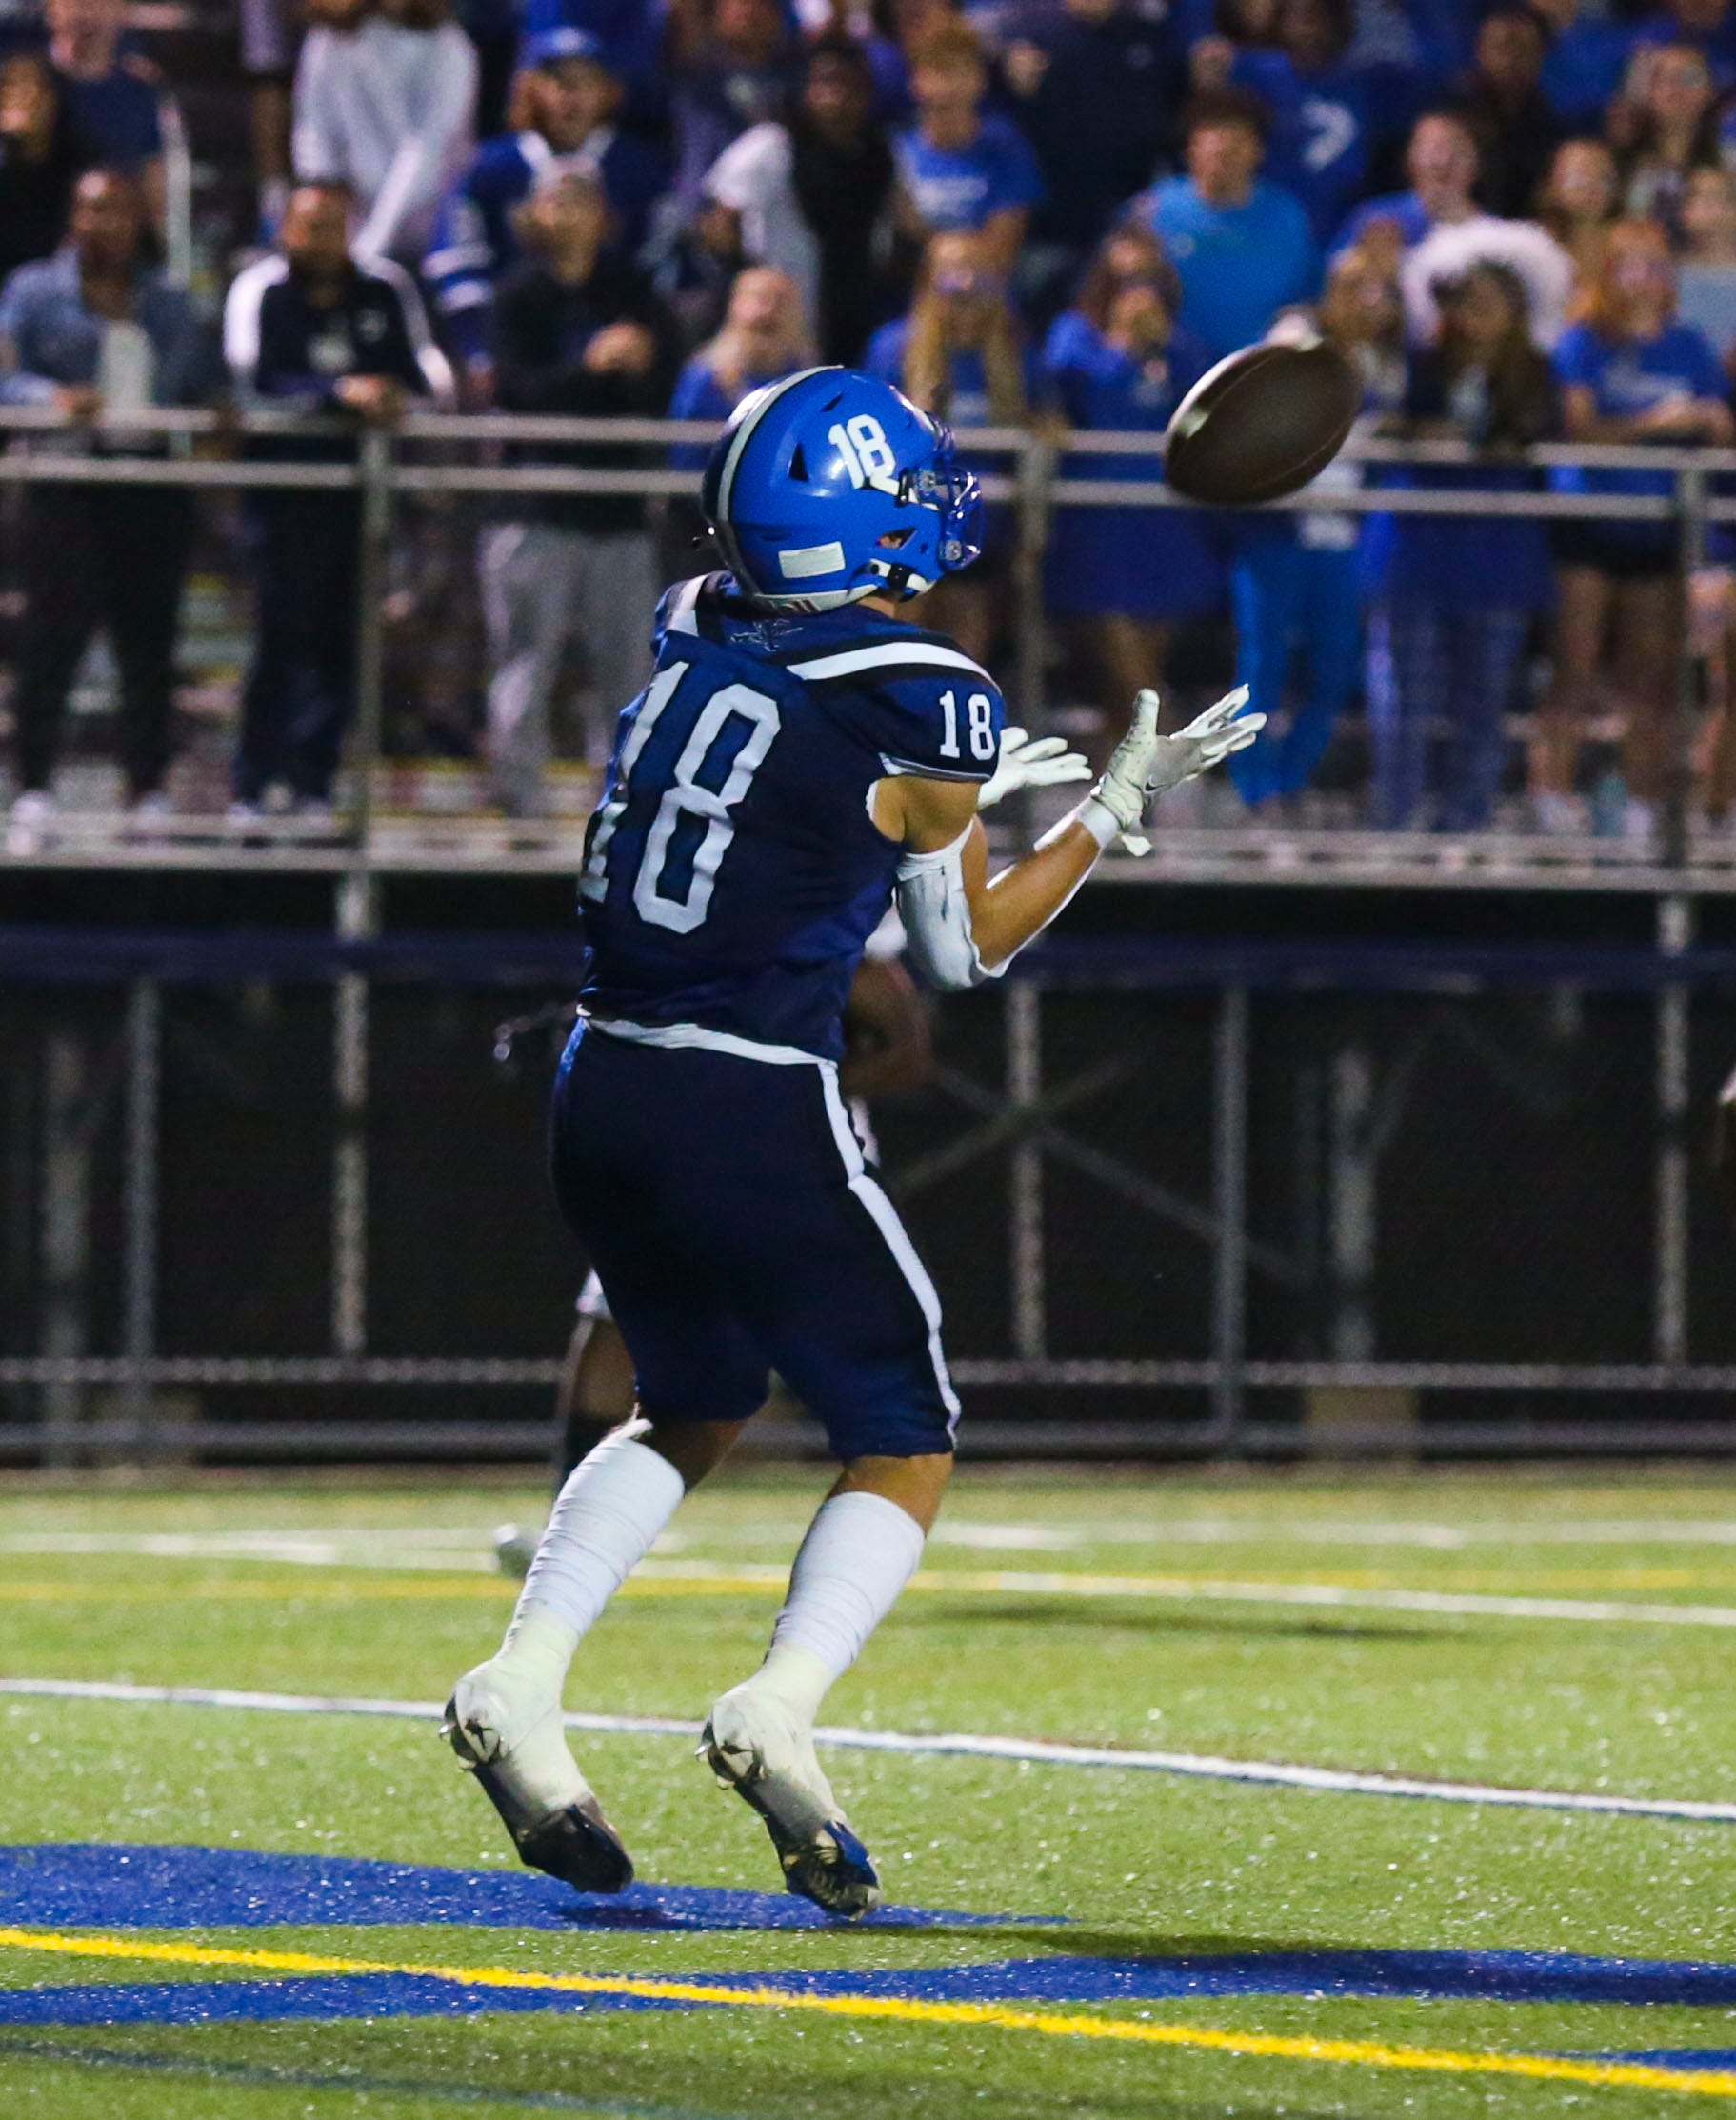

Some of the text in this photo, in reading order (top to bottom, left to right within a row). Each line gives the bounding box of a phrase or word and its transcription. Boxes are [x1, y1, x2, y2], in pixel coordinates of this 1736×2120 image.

[828, 413, 896, 490] 18
[939, 690, 996, 760] 18
[577, 660, 781, 934] 18
